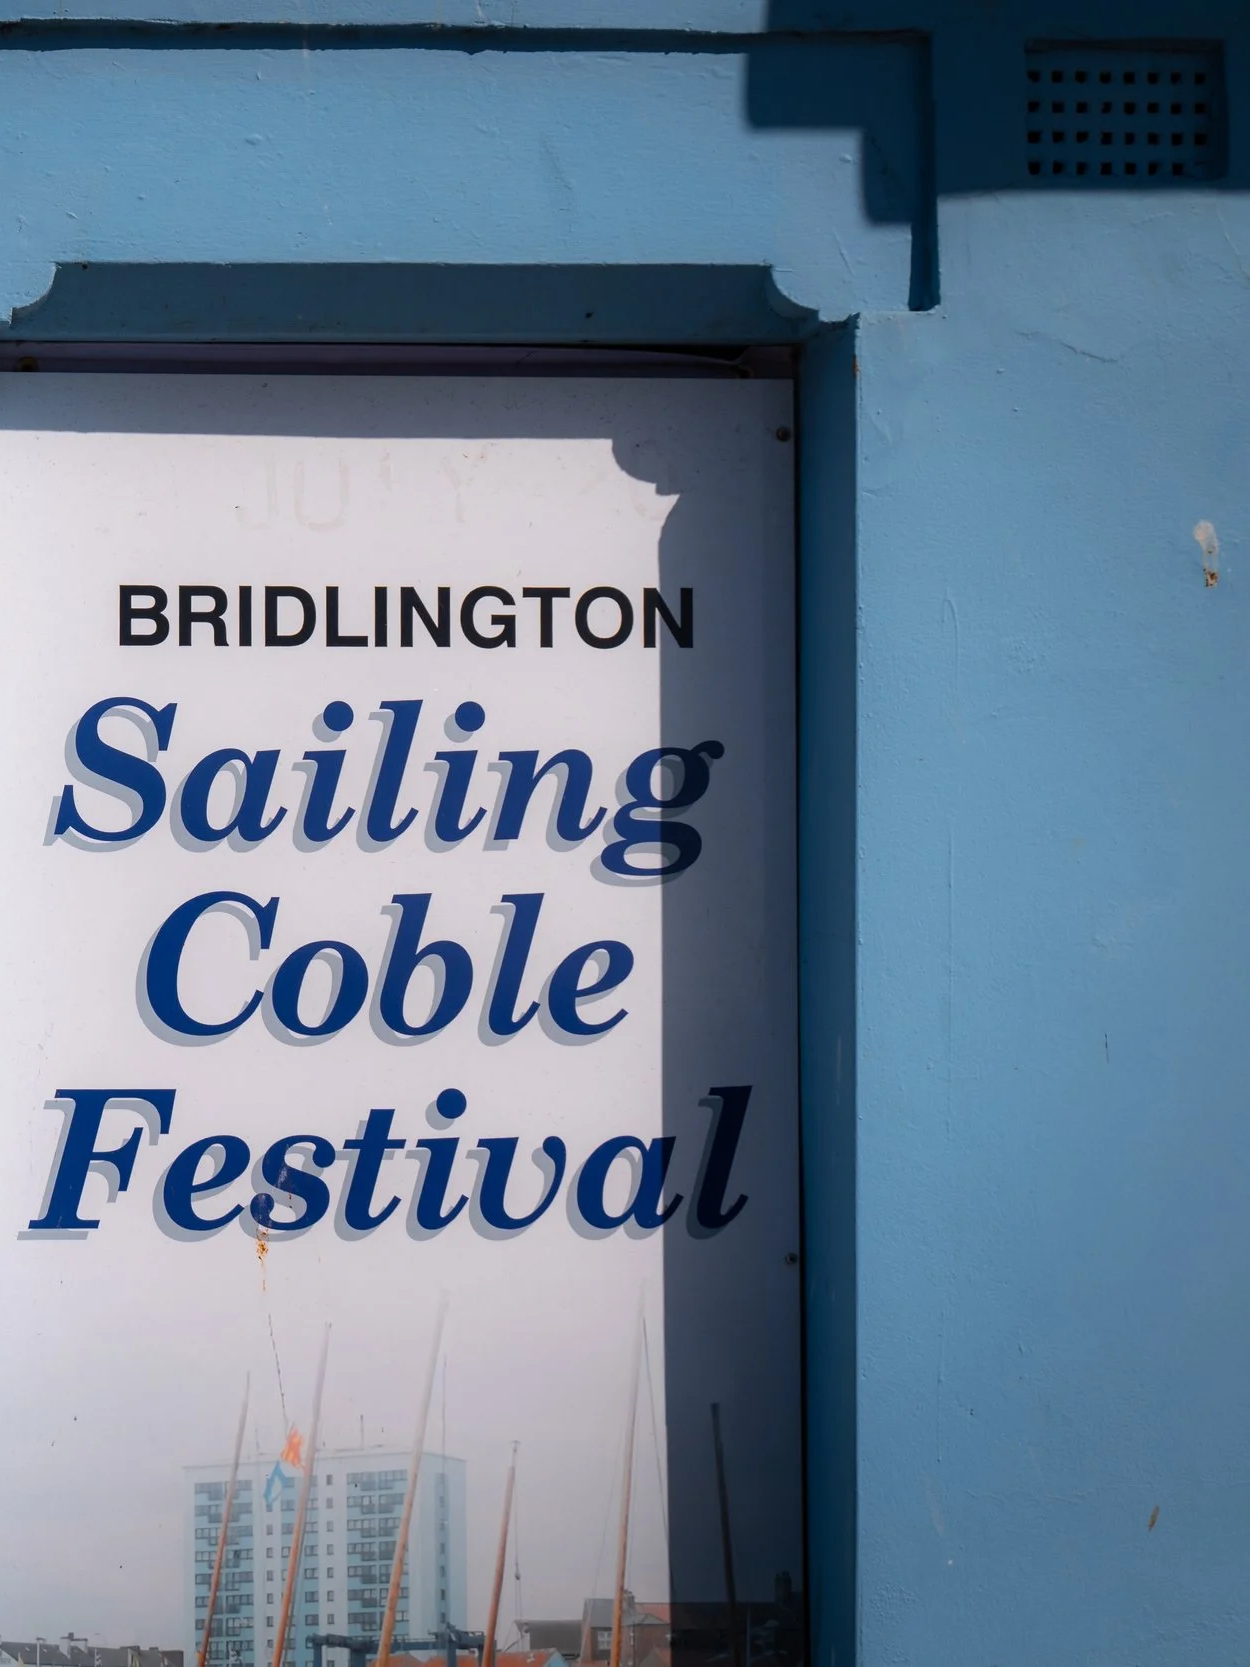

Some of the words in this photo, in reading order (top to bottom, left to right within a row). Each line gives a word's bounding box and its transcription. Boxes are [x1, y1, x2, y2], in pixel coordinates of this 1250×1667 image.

[118, 584, 695, 649] BRIDLINGTON
[52, 695, 726, 877] Sailing
[147, 890, 635, 1037] Coble
[27, 1084, 754, 1231] Festival
